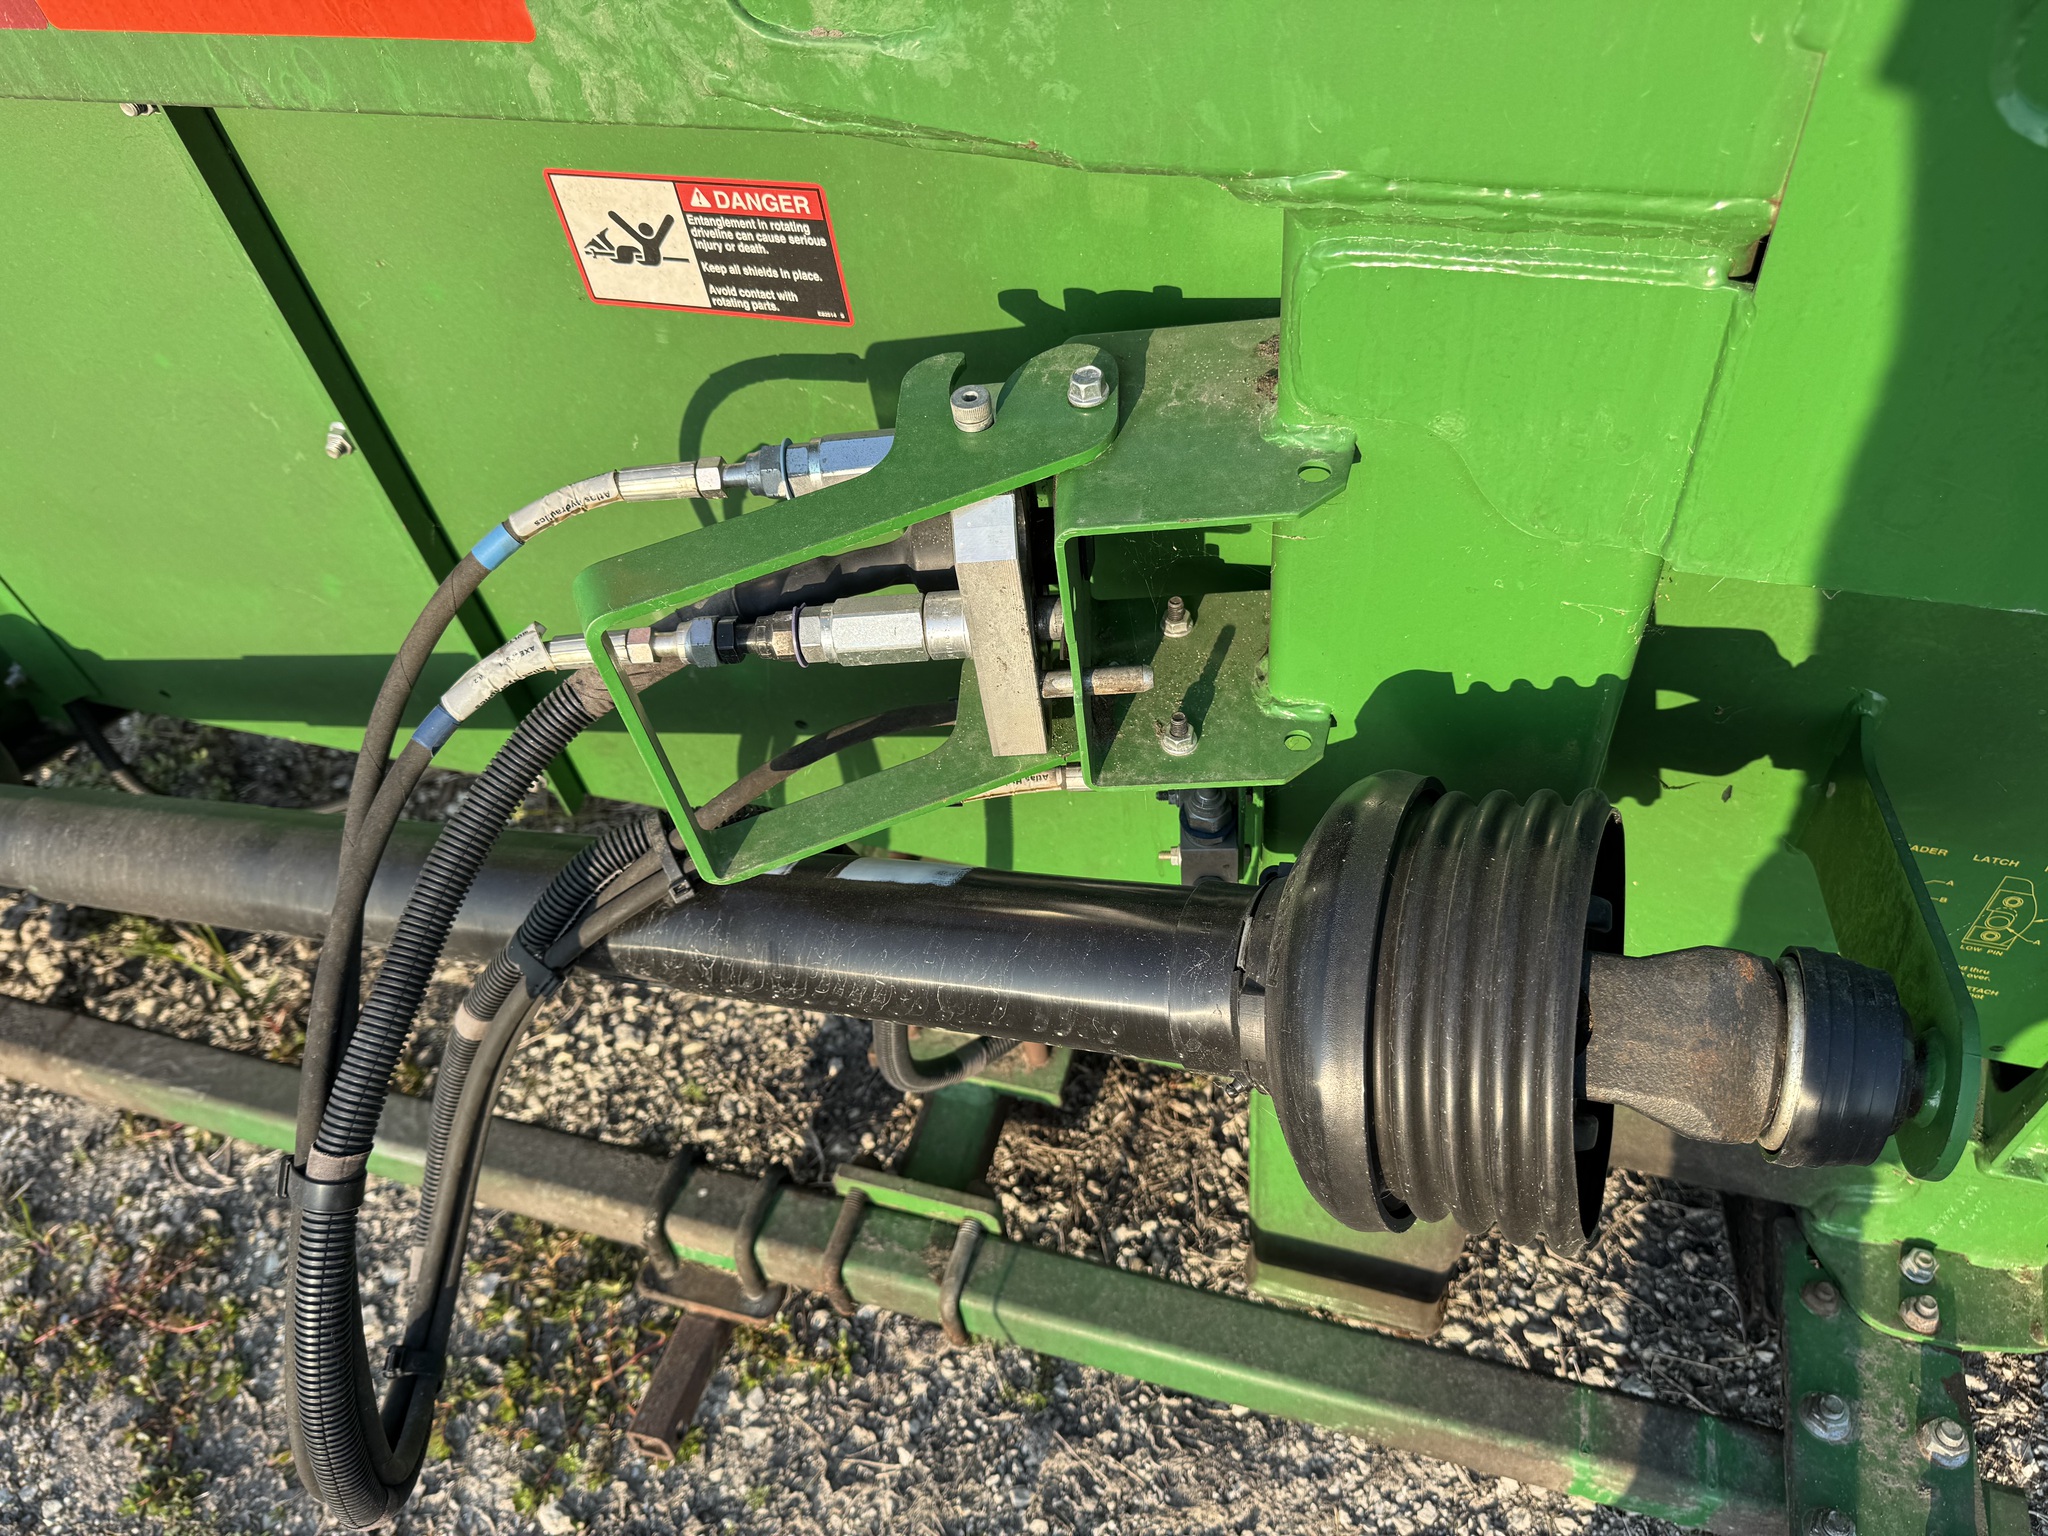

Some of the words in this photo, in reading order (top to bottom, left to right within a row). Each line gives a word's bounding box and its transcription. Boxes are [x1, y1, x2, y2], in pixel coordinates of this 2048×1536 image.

[713, 190, 811, 214] DANGER
[686, 214, 756, 230] Entanglement
[757, 218, 768, 230] in
[770, 220, 811, 236] rotating
[690, 227, 734, 240] driveline
[735, 231, 755, 242] can
[756, 232, 787, 244] cause
[788, 234, 827, 247] serious
[693, 238, 723, 253] injury
[724, 242, 736, 252] or
[737, 241, 769, 254] death.
[701, 261, 727, 276] Keep
[728, 263, 742, 275] all
[742, 264, 779, 279] shields
[779, 266, 791, 279] in
[792, 268, 823, 282] place.
[709, 283, 738, 297] Avoid
[738, 287, 776, 301] contact
[776, 289, 799, 302] with
[711, 297, 750, 311] rotating
[751, 299, 780, 312] parts.
[1908, 843, 1949, 857] ADER
[1973, 854, 2021, 868] LATCH
[1960, 944, 1982, 953] LOW
[1986, 948, 2004, 957] PIN
[1969, 966, 1990, 975] thru
